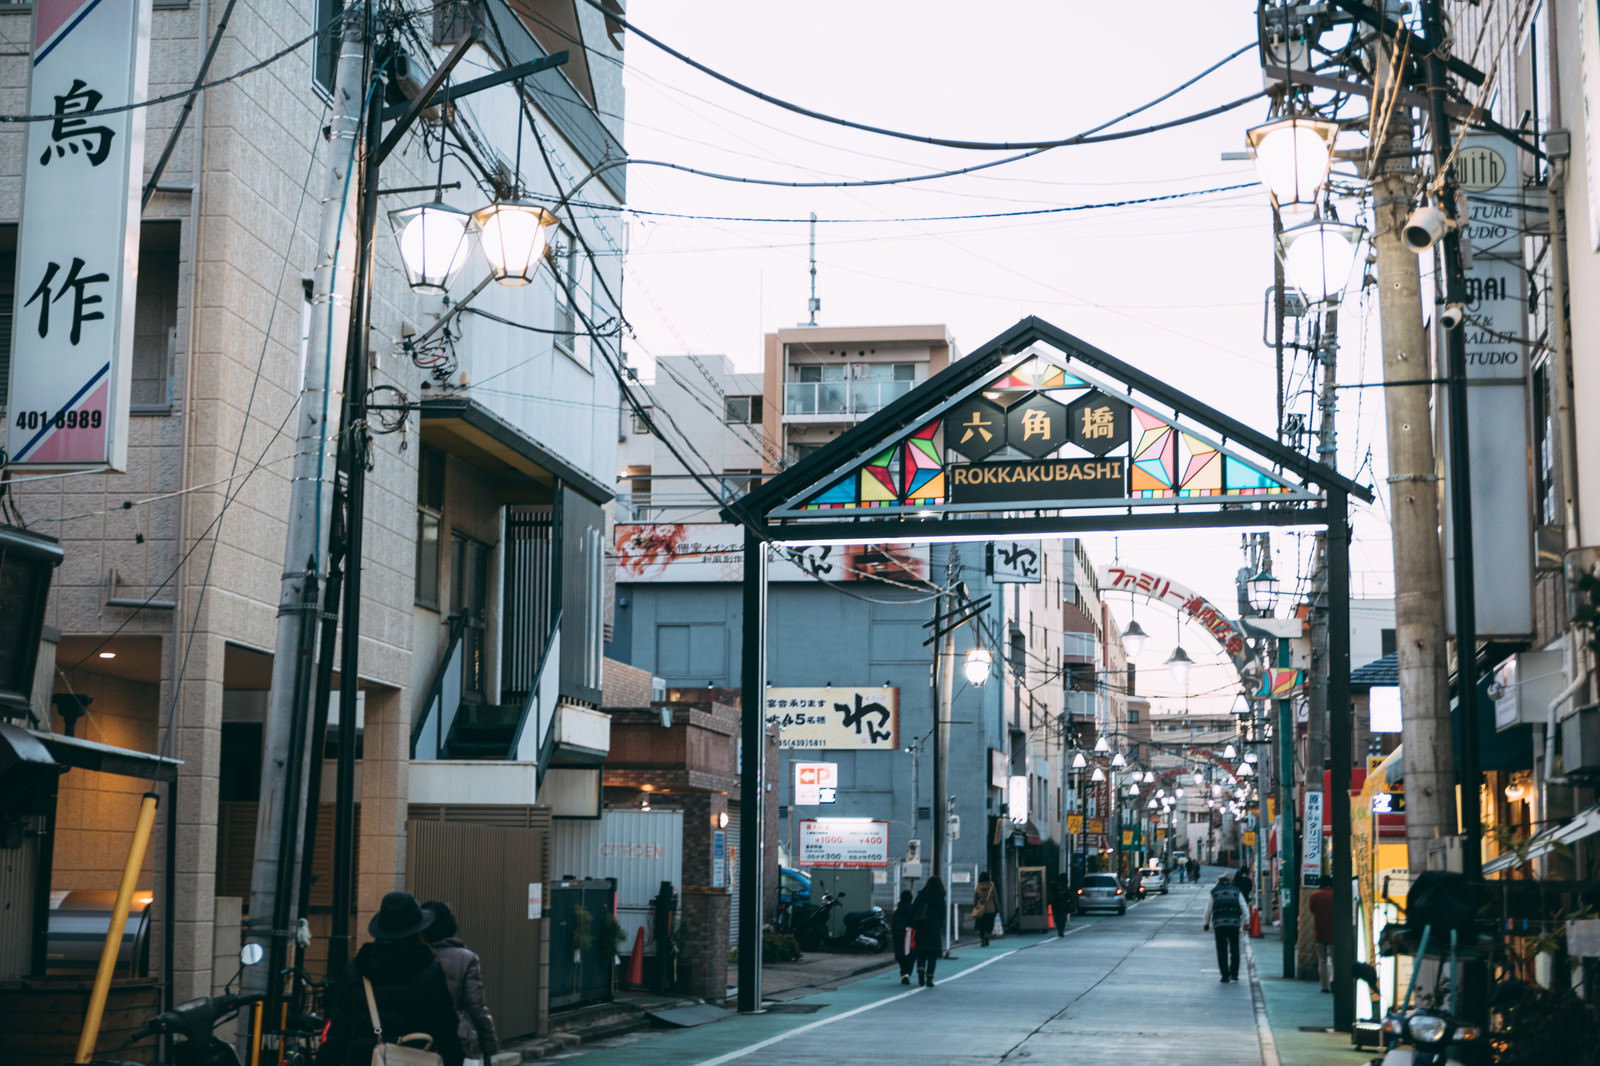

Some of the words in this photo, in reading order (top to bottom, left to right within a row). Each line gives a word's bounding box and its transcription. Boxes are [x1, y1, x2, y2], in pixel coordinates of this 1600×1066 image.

[1456, 152, 1498, 185] with
[1469, 205, 1513, 220] TURE
[1465, 352, 1518, 365] TUDIO
[960, 406, 1115, 444] 六角橋
[954, 461, 1122, 485] ROKKAKUBASHI
[997, 541, 1038, 577] わん
[833, 693, 892, 744] わん
[816, 768, 831, 785] P
